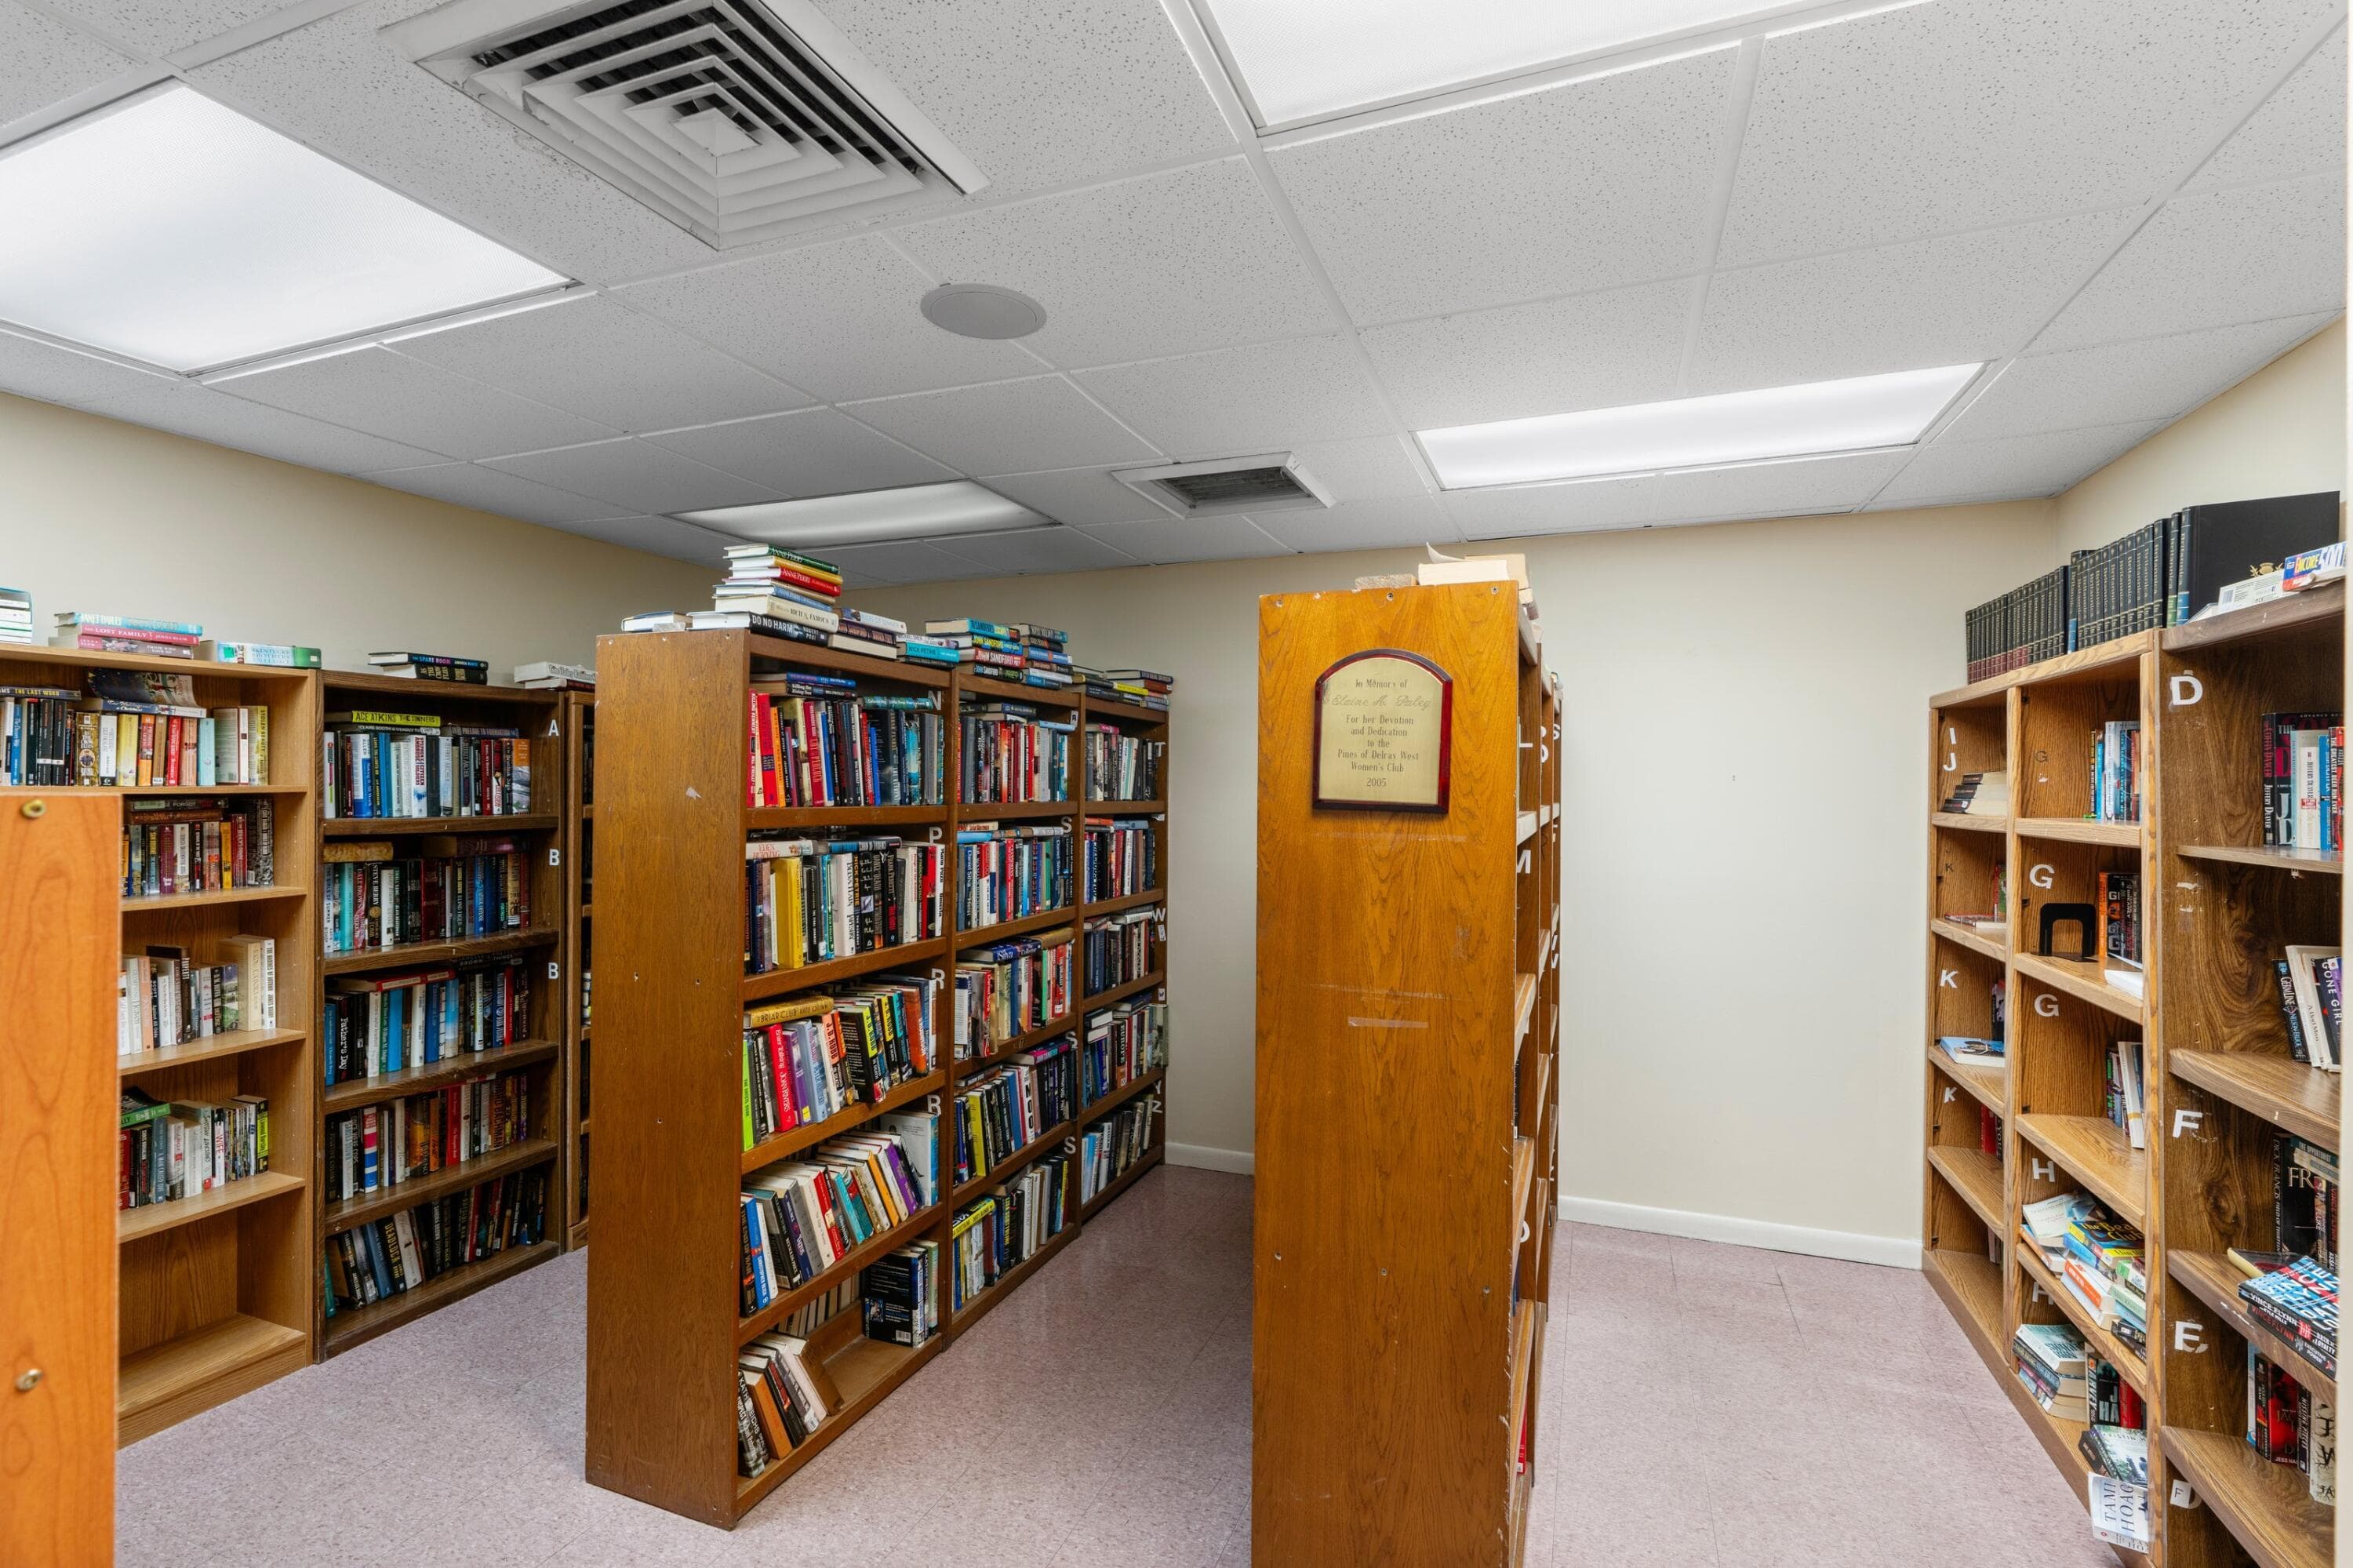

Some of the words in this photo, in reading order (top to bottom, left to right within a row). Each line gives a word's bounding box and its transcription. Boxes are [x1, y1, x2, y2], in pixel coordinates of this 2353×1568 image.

[2296, 554, 2321, 573] ENCORE
[752, 614, 762, 625] DO
[762, 617, 773, 628] NO
[773, 620, 793, 634] HARM
[118, 629, 147, 638] FAMILY
[976, 650, 990, 660] JOHN
[990, 653, 1014, 665] SANDFORD
[1355, 678, 1363, 688] In
[1400, 678, 1408, 688] of
[2169, 675, 2203, 706] D
[928, 690, 941, 711] N
[355, 710, 370, 723] ACE
[370, 711, 397, 724] ATKINS
[411, 715, 435, 724] SINNERS
[1346, 714, 1359, 724] For
[1362, 714, 1375, 725] her
[1379, 715, 1415, 726] Devotion
[548, 719, 559, 737] A
[1351, 726, 1365, 736] and
[1367, 727, 1408, 737] Dedication
[2278, 724, 2295, 735] THE
[1155, 741, 1166, 757] T
[1367, 739, 1375, 748] to
[1378, 739, 1391, 748] the
[1337, 749, 1358, 759] Pines
[1360, 749, 1369, 759] of
[1400, 751, 1420, 761] West
[1943, 752, 1957, 772] J
[2035, 751, 2048, 763] G
[2264, 751, 2274, 777] DANCER
[1351, 762, 1384, 772] Women's
[1387, 762, 1405, 773] Club
[1366, 777, 1387, 788] 2005
[2264, 784, 2274, 806] JEFFERY
[1061, 817, 1073, 835] S
[2264, 806, 2275, 829] DEAVER
[929, 828, 943, 845] P
[549, 849, 560, 866] B
[2030, 864, 2055, 890] G
[1151, 908, 1166, 922] W
[997, 949, 1013, 962] Silva
[548, 962, 559, 980] B
[931, 968, 945, 990] R
[1940, 970, 1958, 989] K
[2321, 962, 2337, 995] GONE
[2330, 1000, 2341, 1026] GIRL
[761, 1010, 780, 1022] BRIAR
[780, 1009, 797, 1020] CLUB
[799, 1006, 811, 1015] KATE
[2034, 994, 2060, 1017] G
[340, 1017, 349, 1054] Father's
[826, 1022, 835, 1039] J.D.
[829, 1039, 838, 1059] ROBB
[1065, 1031, 1078, 1050] S
[339, 1054, 347, 1070] Day
[781, 1089, 791, 1112] RIVERS
[1944, 1086, 1958, 1104] K
[926, 1095, 941, 1115] R
[1151, 1101, 1163, 1114] Z
[2173, 1109, 2203, 1139] F
[1064, 1136, 1077, 1155] S
[2031, 1158, 2055, 1183] H
[2273, 1163, 2282, 1200] FRANCIS
[2107, 1231, 2145, 1242] Club
[744, 1243, 751, 1253] OF
[2250, 1293, 2275, 1313] VINCE
[2275, 1308, 2298, 1326] FLYNN
[2264, 1307, 2275, 1317] KYLE
[2275, 1313, 2288, 1326] MILLS
[2252, 1307, 2271, 1324] VINCE
[2271, 1319, 2295, 1342] FLYNN
[2174, 1320, 2202, 1351] E
[2304, 1341, 2327, 1360] EXECUTIVE
[2314, 1339, 2336, 1354] LOYALTY
[2306, 1348, 2323, 1364] POWER
[2173, 1486, 2184, 1499] F
[2103, 1482, 2117, 1523] TAMI
[2119, 1482, 2135, 1533] HOAG
